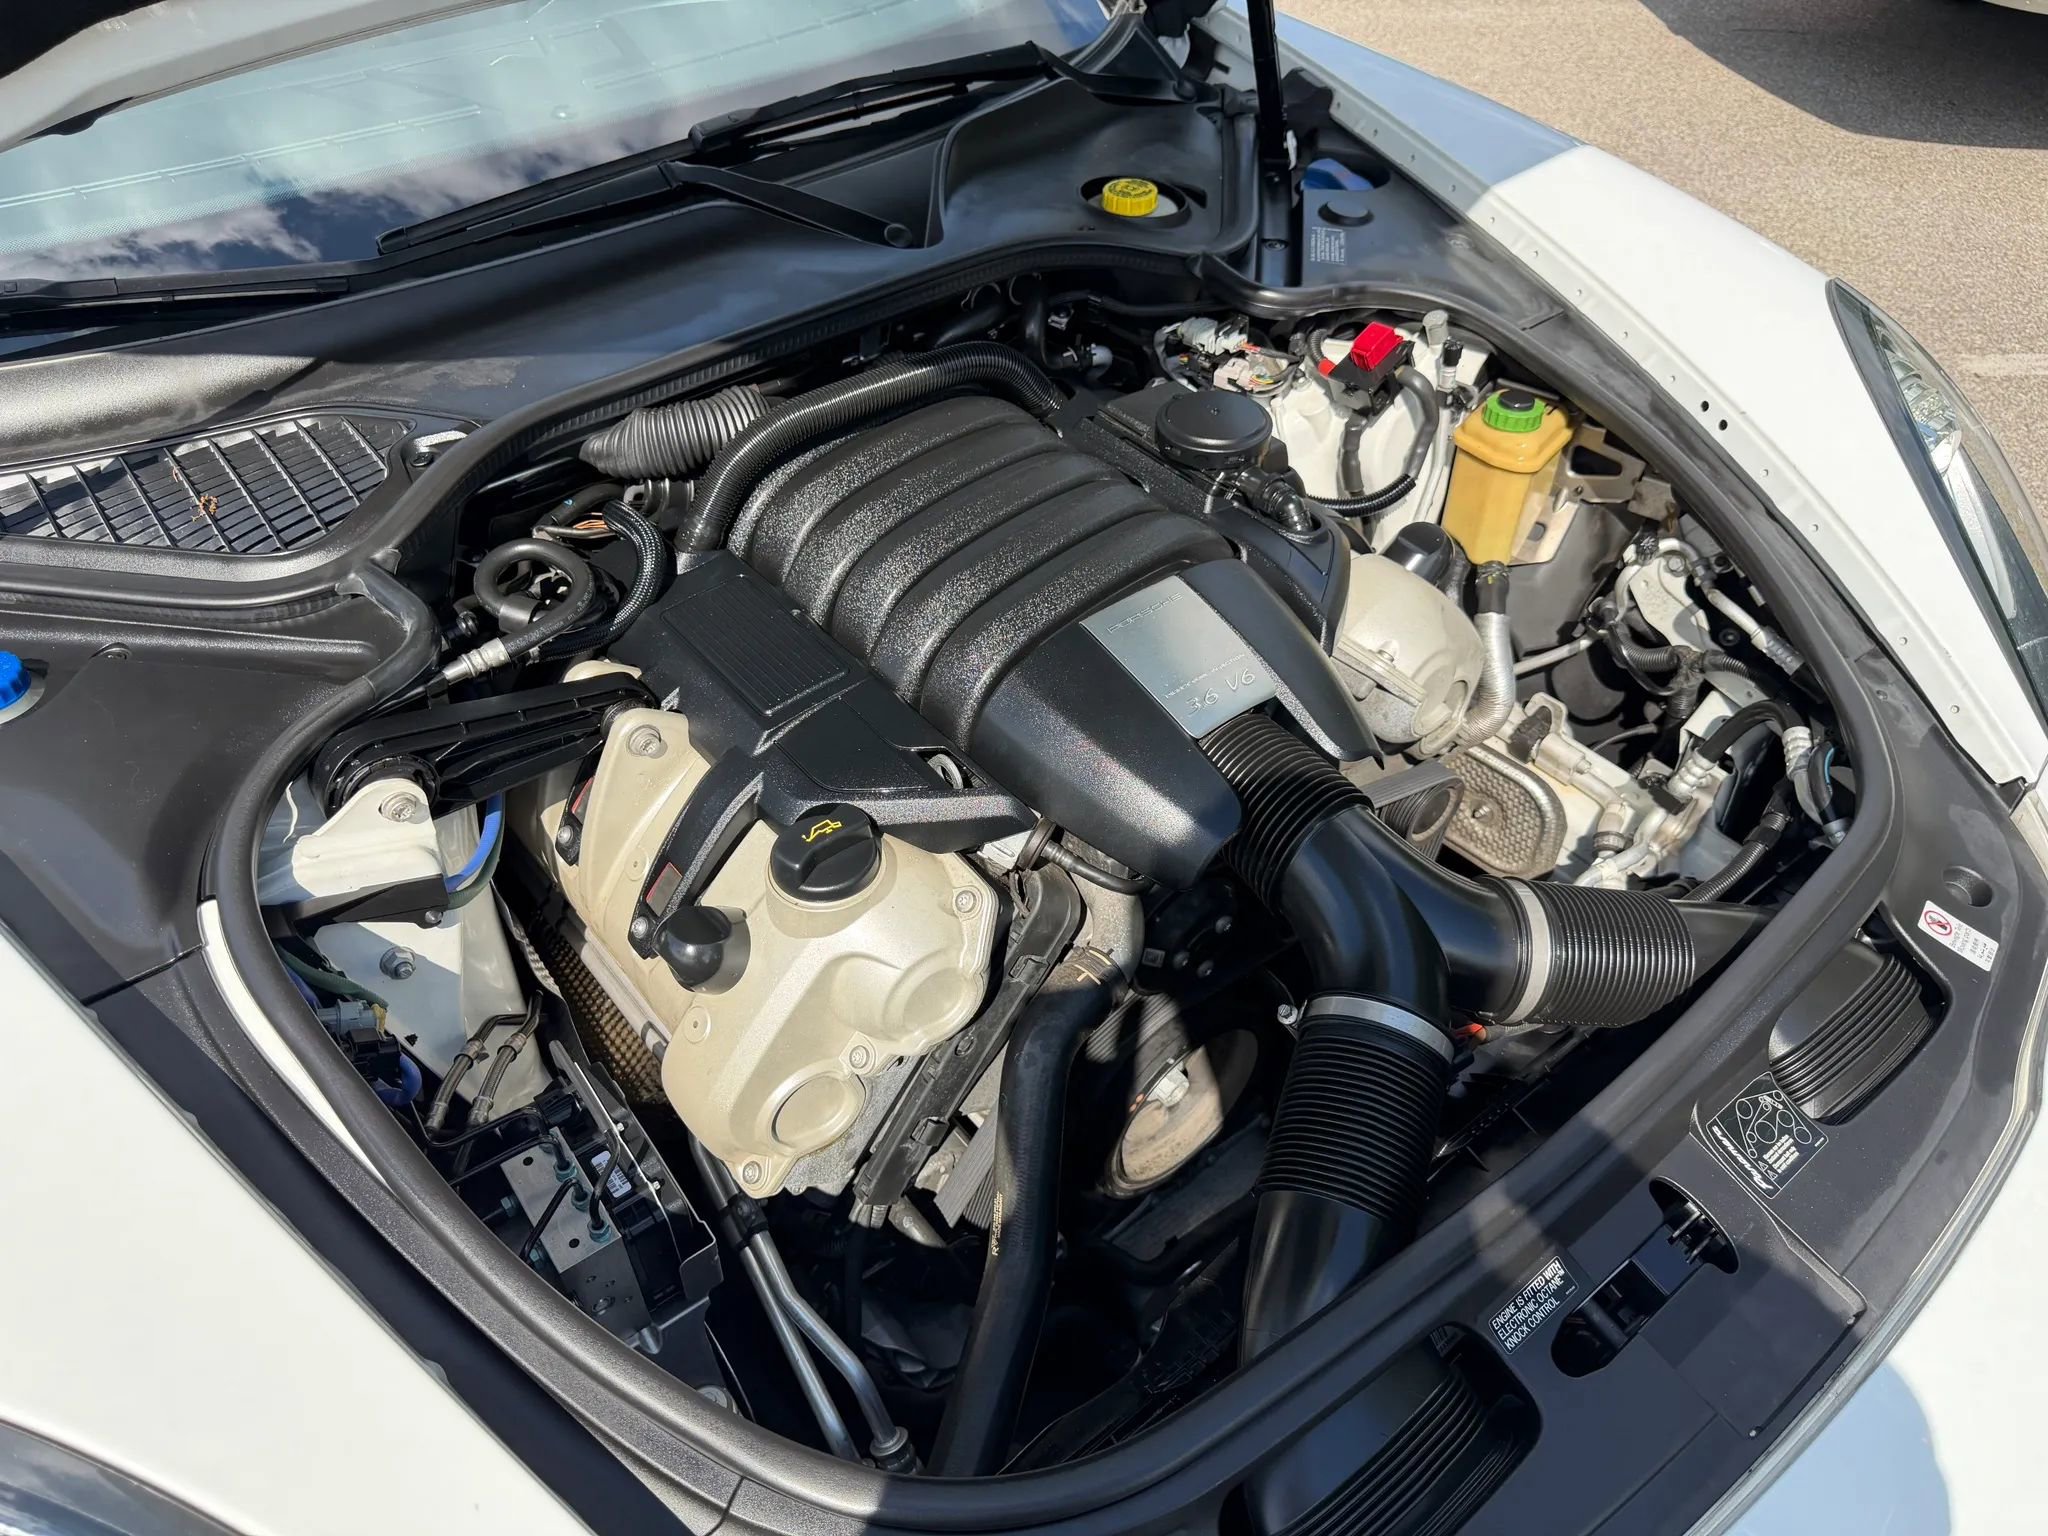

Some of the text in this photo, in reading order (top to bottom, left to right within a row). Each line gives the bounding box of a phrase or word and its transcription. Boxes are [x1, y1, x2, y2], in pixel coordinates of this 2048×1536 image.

[1107, 592, 1184, 634] PORSCHE
[1185, 687, 1220, 717] 3.6
[1225, 668, 1256, 692] V6
[1712, 1125, 1774, 1190] Panamera
[1492, 1302, 1518, 1330] ENGINE
[1515, 1295, 1525, 1308] IS
[1522, 1275, 1546, 1301] FITTED
[1542, 1259, 1562, 1281] WITH
[1497, 1298, 1539, 1341] ELECTRONIC
[1504, 1296, 1560, 1351] KNOCK CONTROL
